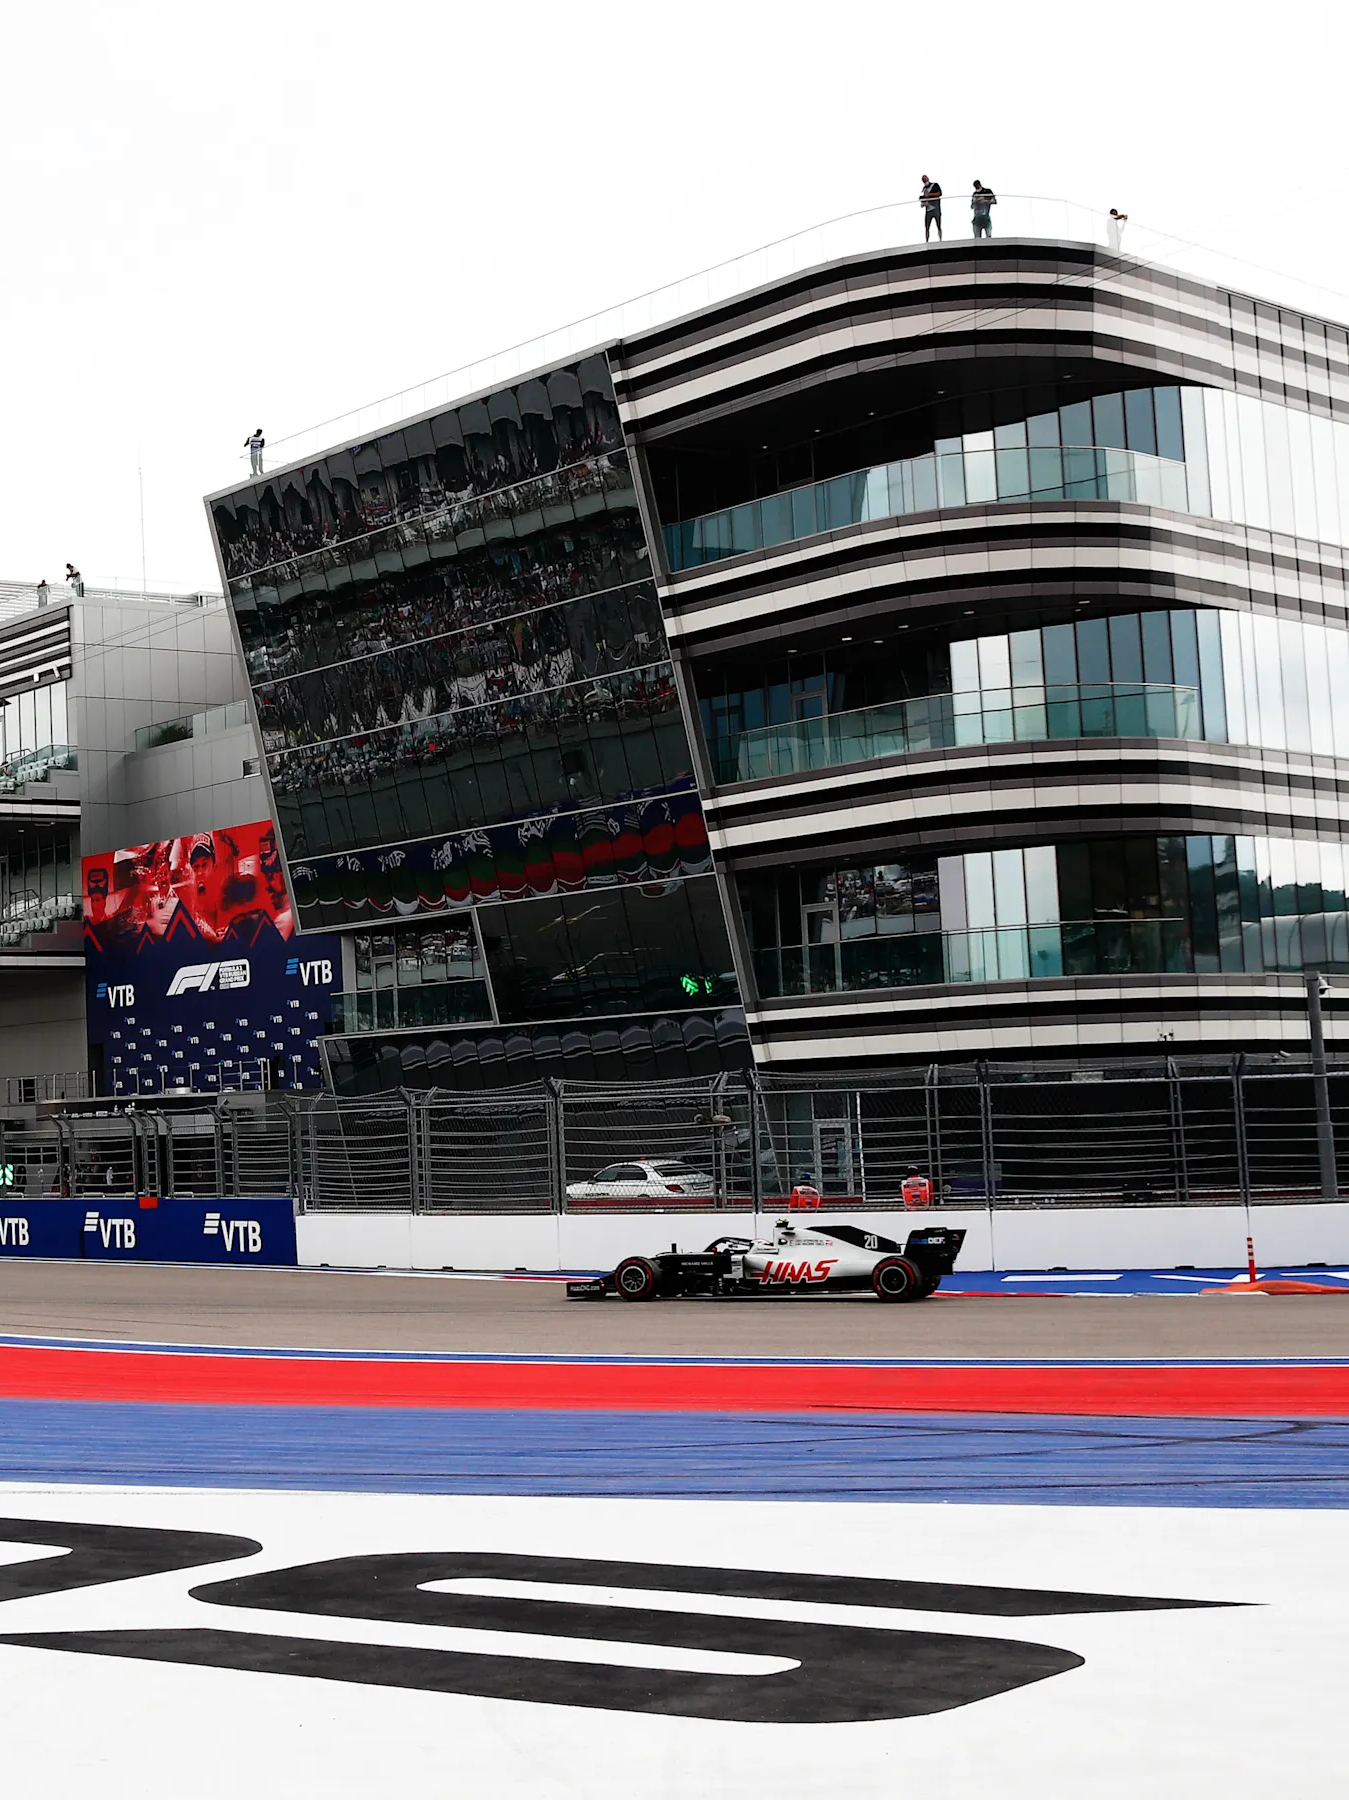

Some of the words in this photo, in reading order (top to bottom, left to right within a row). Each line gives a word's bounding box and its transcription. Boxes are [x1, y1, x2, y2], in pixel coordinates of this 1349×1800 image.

[300, 960, 332, 985] VTB
[108, 985, 134, 1007] VTB
[100, 1219, 135, 1248] VTB
[221, 1221, 261, 1252] VTB
[864, 1235, 878, 1249] 20
[749, 1259, 839, 1284] HAAS
